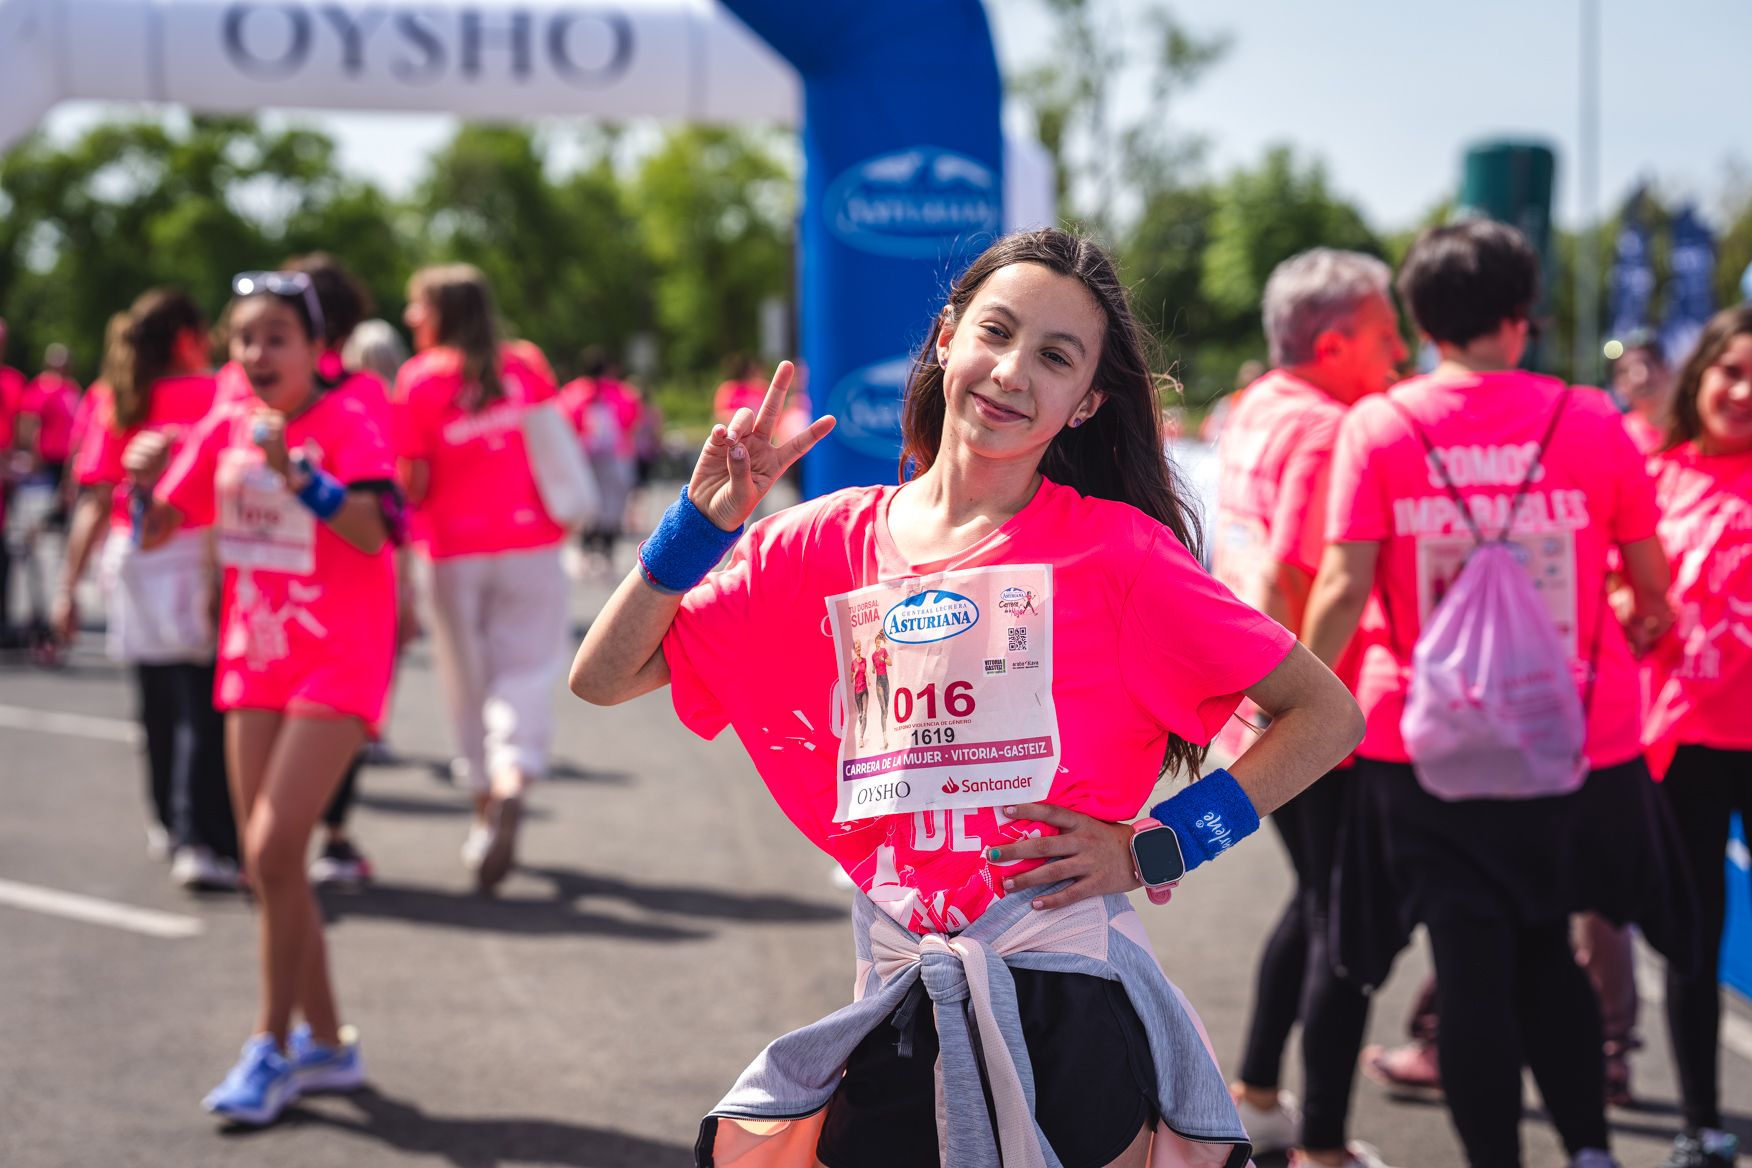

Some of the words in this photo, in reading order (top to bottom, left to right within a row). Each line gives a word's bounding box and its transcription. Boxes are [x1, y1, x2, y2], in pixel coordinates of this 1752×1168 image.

[220, 0, 638, 91] OYSHO
[1427, 440, 1546, 488] SOMOS
[1392, 489, 1590, 536] IMPARABLES
[849, 606, 857, 614] TU
[857, 600, 879, 613] DORSAL
[851, 607, 880, 628] SUMA
[901, 608, 934, 617] CENTRAL
[935, 603, 968, 612] LECHERA
[889, 610, 972, 635] ASTURIANA
[893, 680, 976, 723] 016
[911, 727, 955, 746] 1619
[845, 760, 880, 776] CARRERA
[881, 757, 892, 770] DE
[892, 756, 902, 767] LA
[903, 751, 942, 765] MUJER
[951, 741, 1047, 761] VITORIA-GASTEIZ
[857, 781, 911, 805] OYSHO
[961, 775, 1032, 793] Santander
